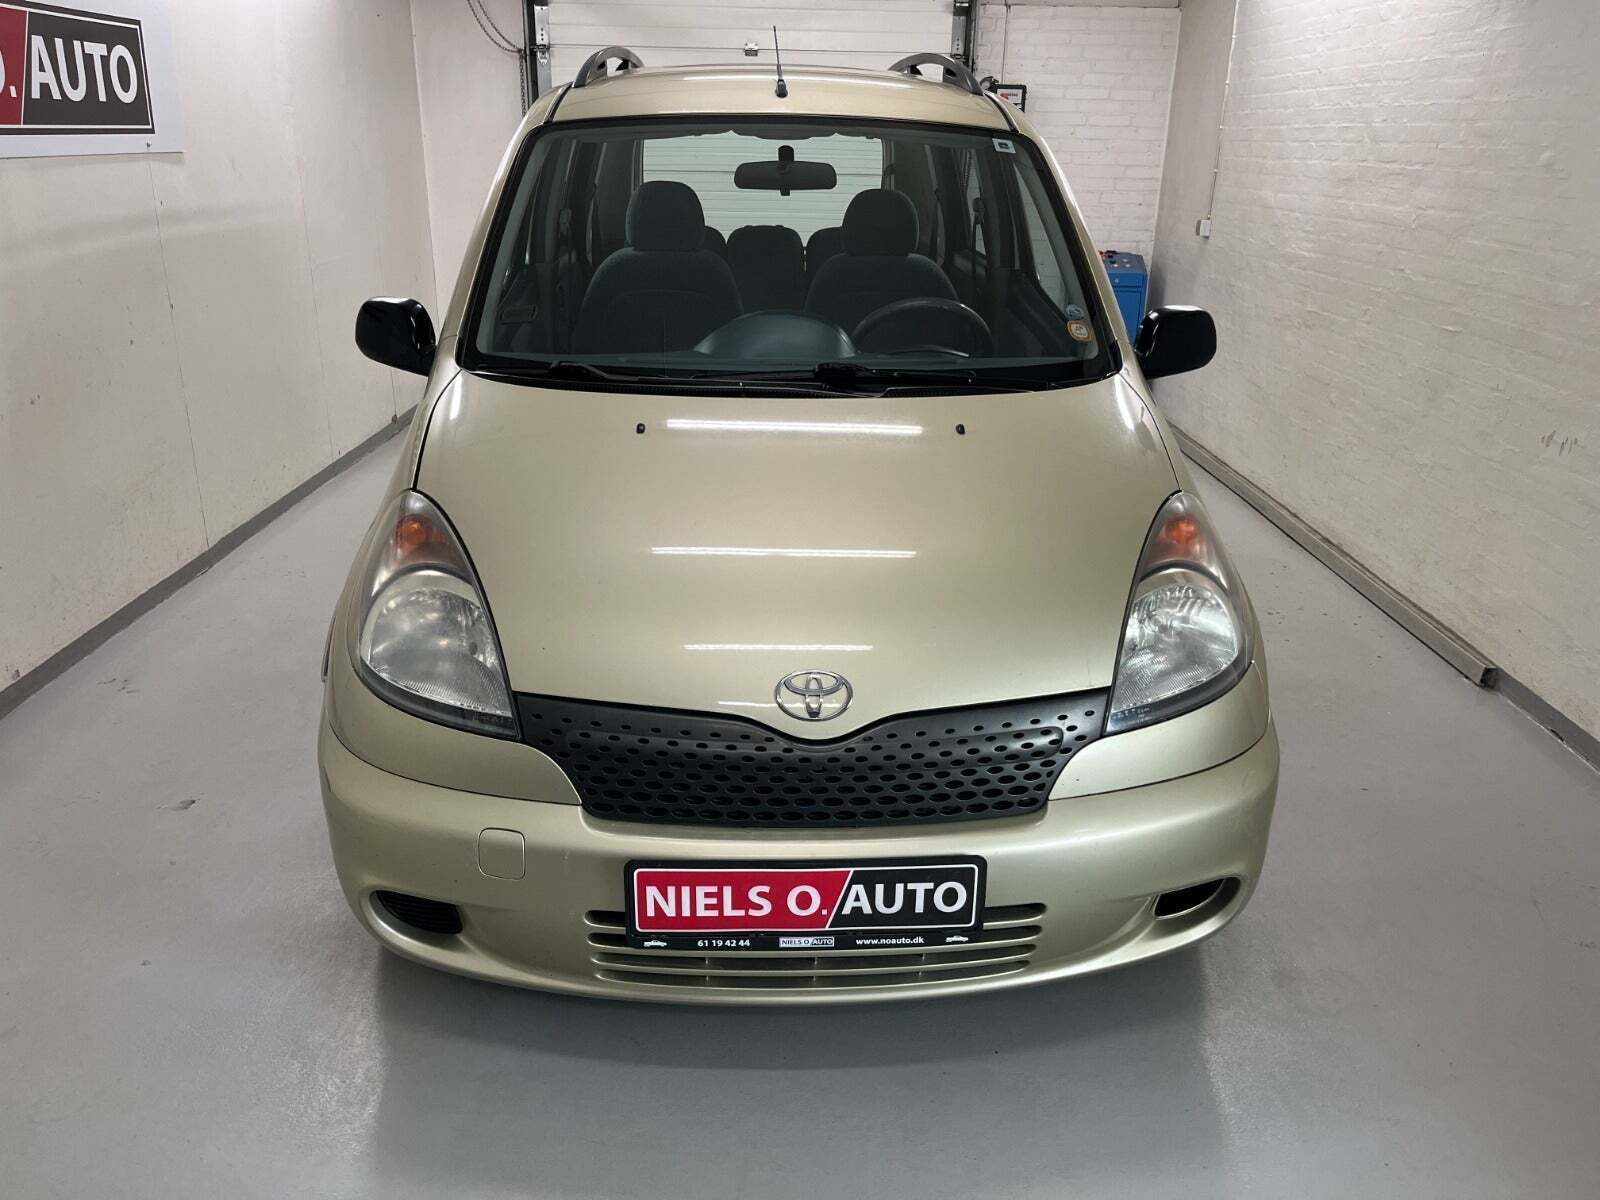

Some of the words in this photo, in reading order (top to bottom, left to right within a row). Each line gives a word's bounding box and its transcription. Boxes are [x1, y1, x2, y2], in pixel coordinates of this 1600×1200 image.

[31, 34, 138, 104] AUTO
[645, 885, 772, 917] NIELS
[786, 884, 828, 917] O.
[841, 881, 967, 915] AUTO
[724, 939, 736, 947] 42
[738, 939, 750, 947] 44
[856, 936, 924, 945] www.noauto.dk
